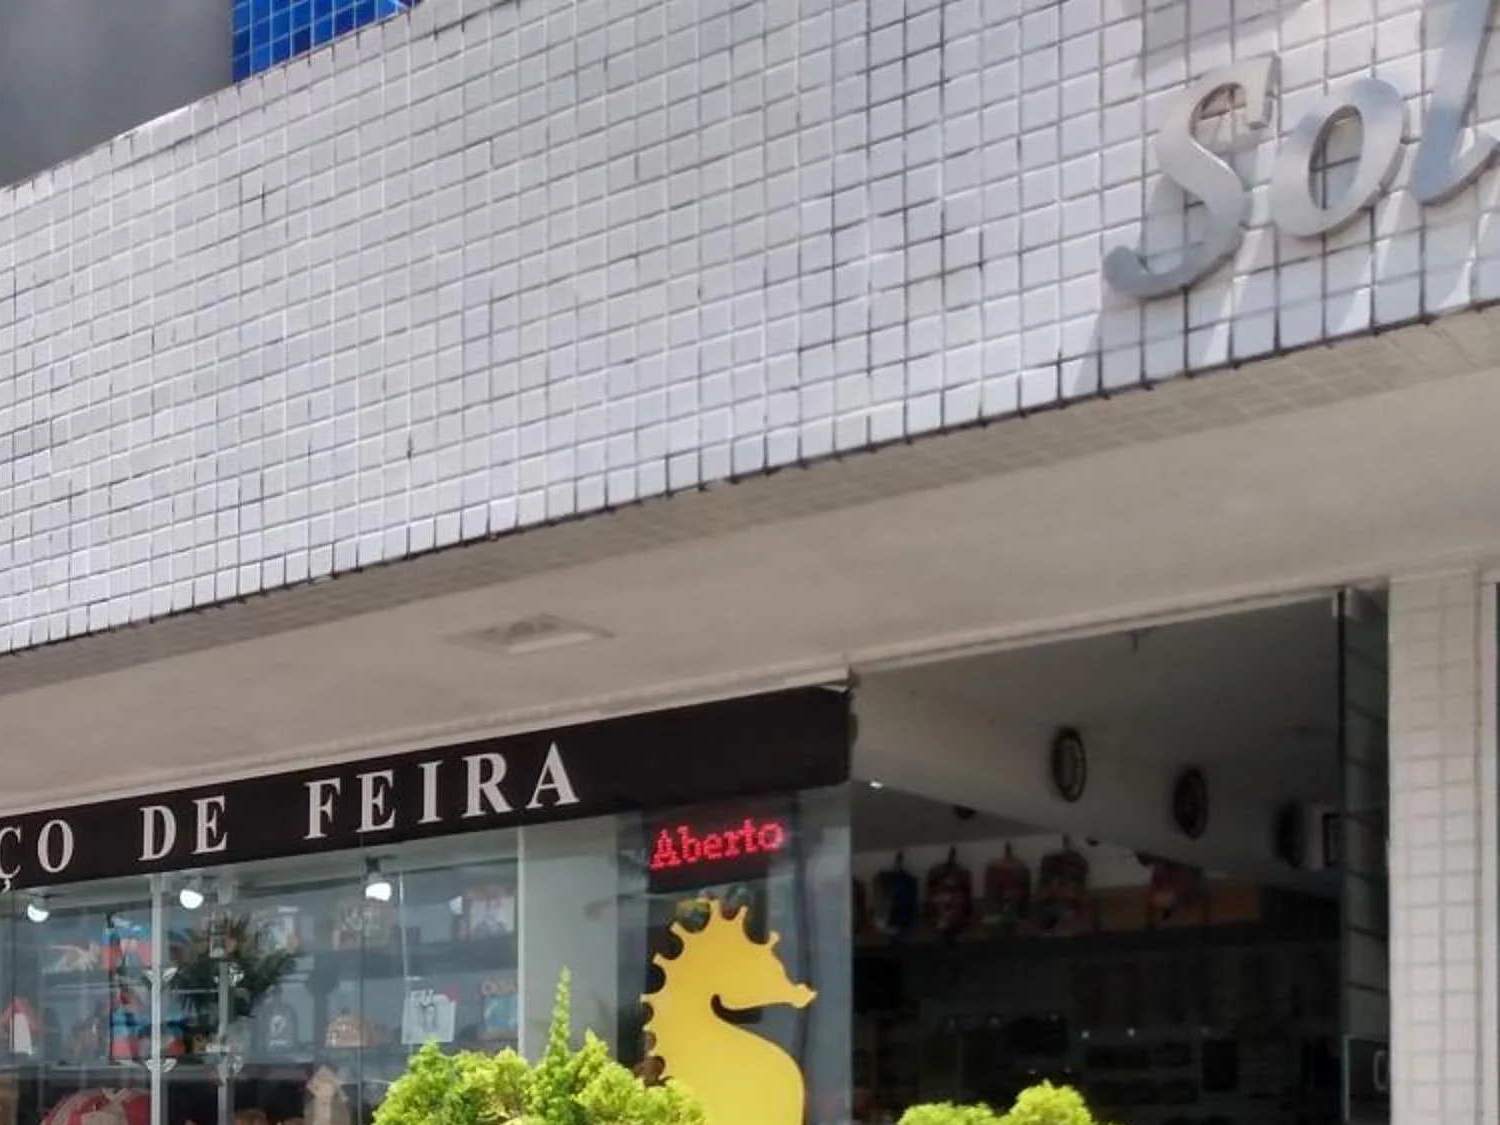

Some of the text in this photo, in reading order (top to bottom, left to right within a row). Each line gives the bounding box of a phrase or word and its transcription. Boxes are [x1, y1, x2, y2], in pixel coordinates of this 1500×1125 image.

[136, 795, 229, 862] DE
[303, 741, 581, 840] FEIRA
[648, 816, 787, 871] Aberto
